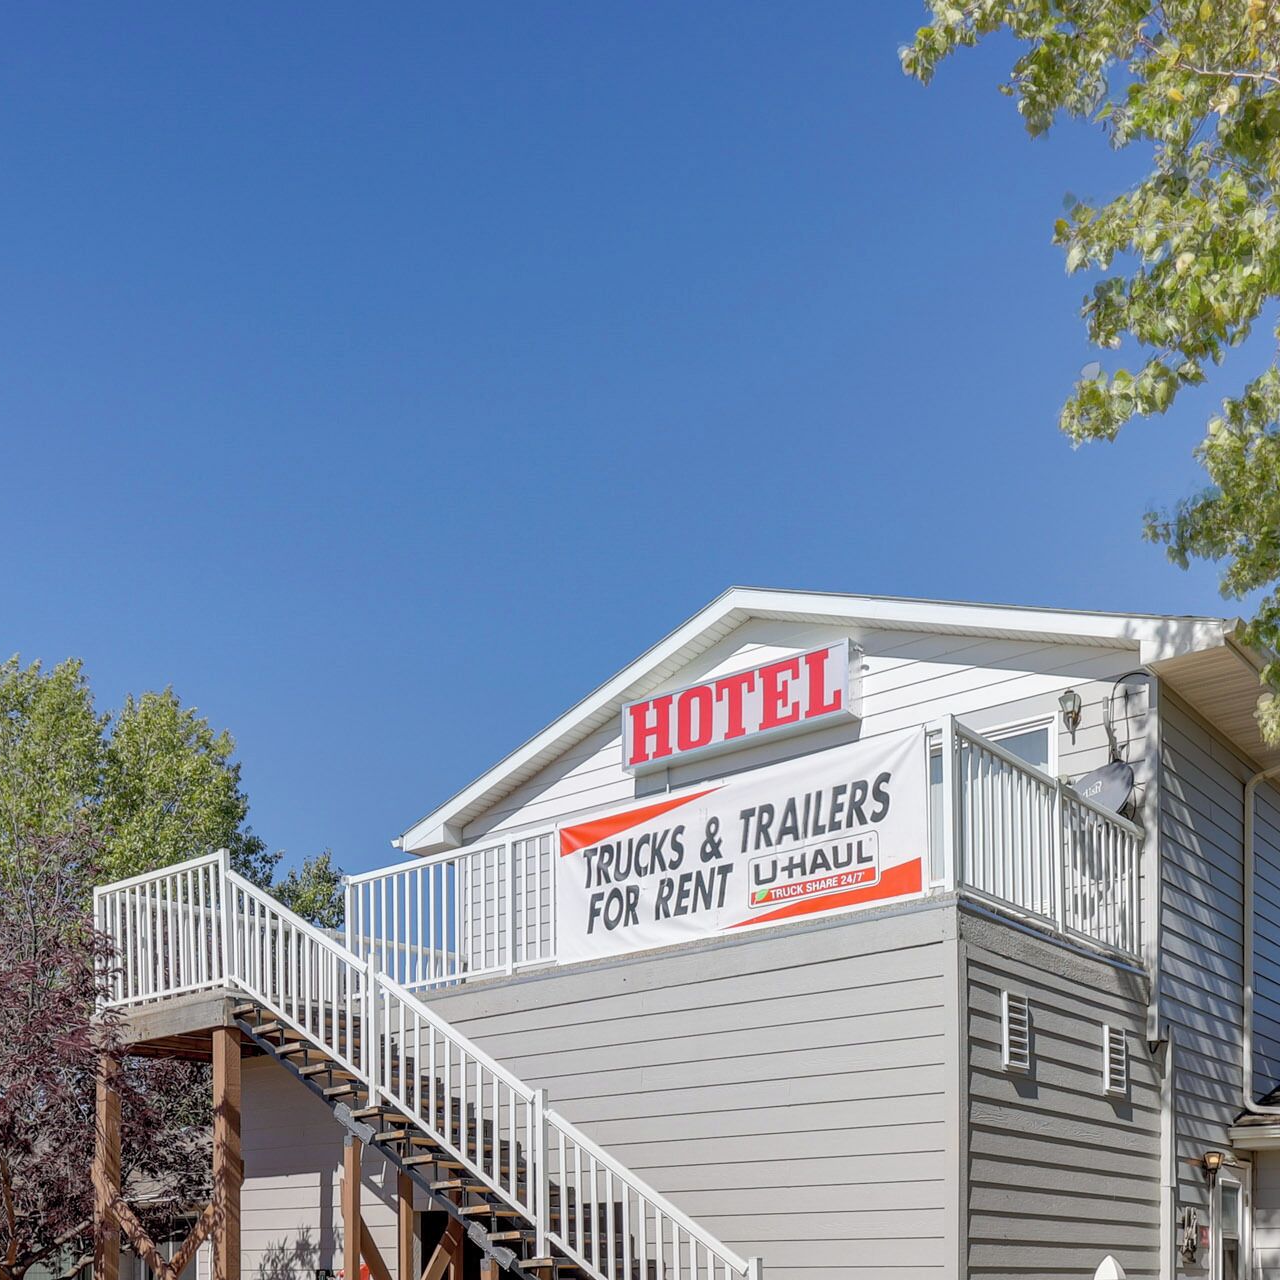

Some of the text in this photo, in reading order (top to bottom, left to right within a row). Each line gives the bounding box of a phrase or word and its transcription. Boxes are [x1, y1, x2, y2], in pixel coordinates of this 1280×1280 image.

[629, 648, 842, 766] HOTEL
[583, 772, 892, 889] TRUCKS & TRAILERS
[587, 863, 734, 934] FOR RENT
[770, 885, 804, 899] TRUCK
[806, 877, 838, 893] SHARE
